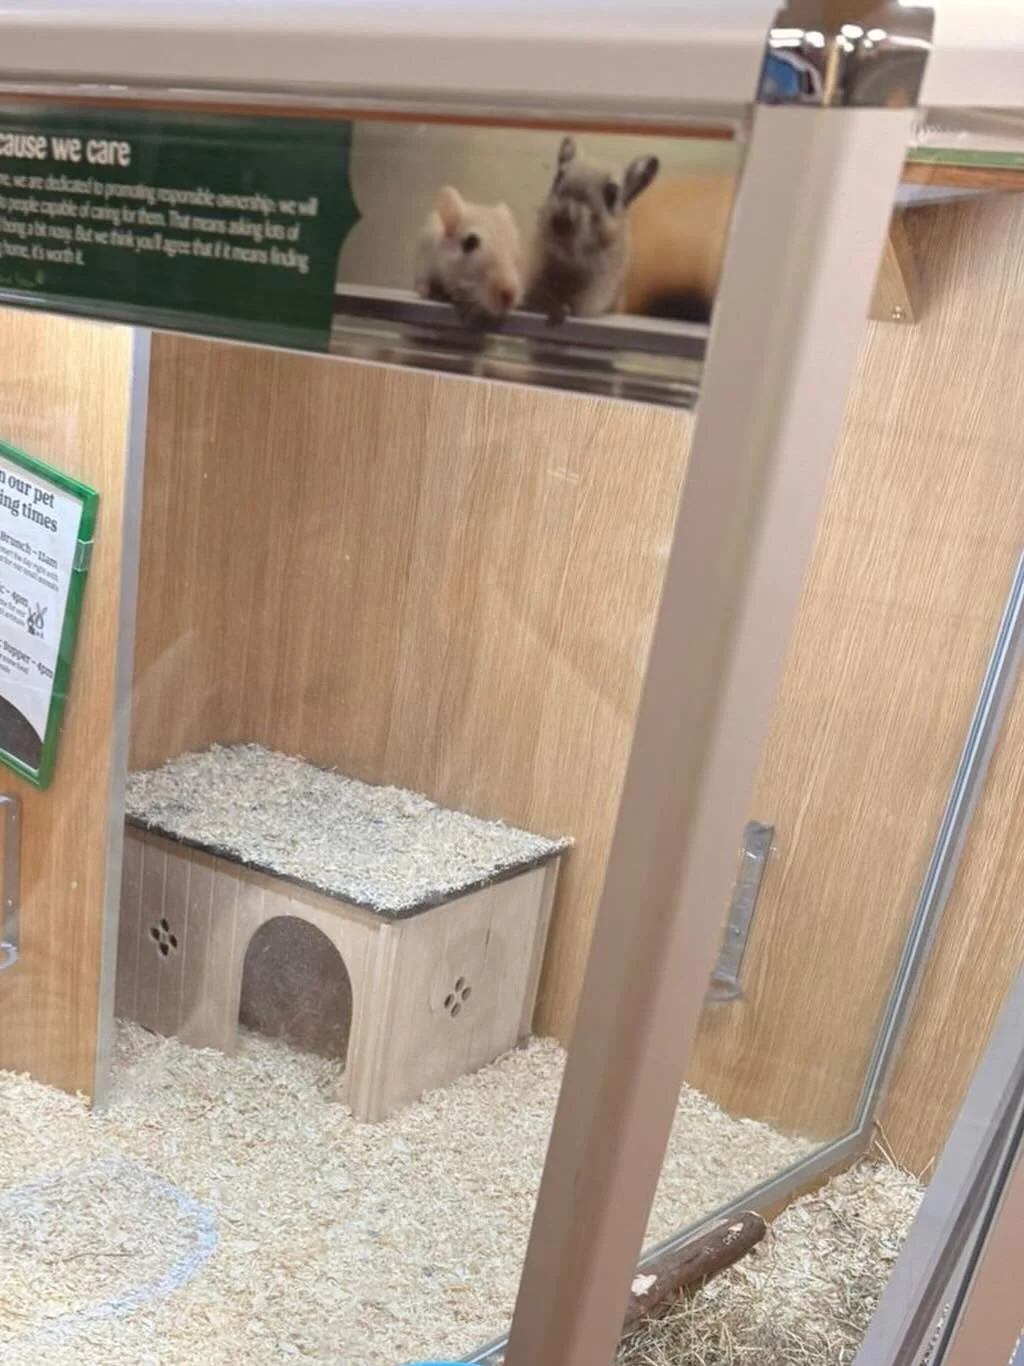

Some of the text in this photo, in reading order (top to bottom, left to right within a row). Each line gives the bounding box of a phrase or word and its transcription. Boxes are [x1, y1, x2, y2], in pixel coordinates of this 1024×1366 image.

[51, 137, 82, 162] we
[85, 139, 131, 167] care
[7, 474, 32, 496] our
[33, 487, 56, 508] pet
[21, 503, 58, 533] times
[1, 641, 32, 664] Supper
